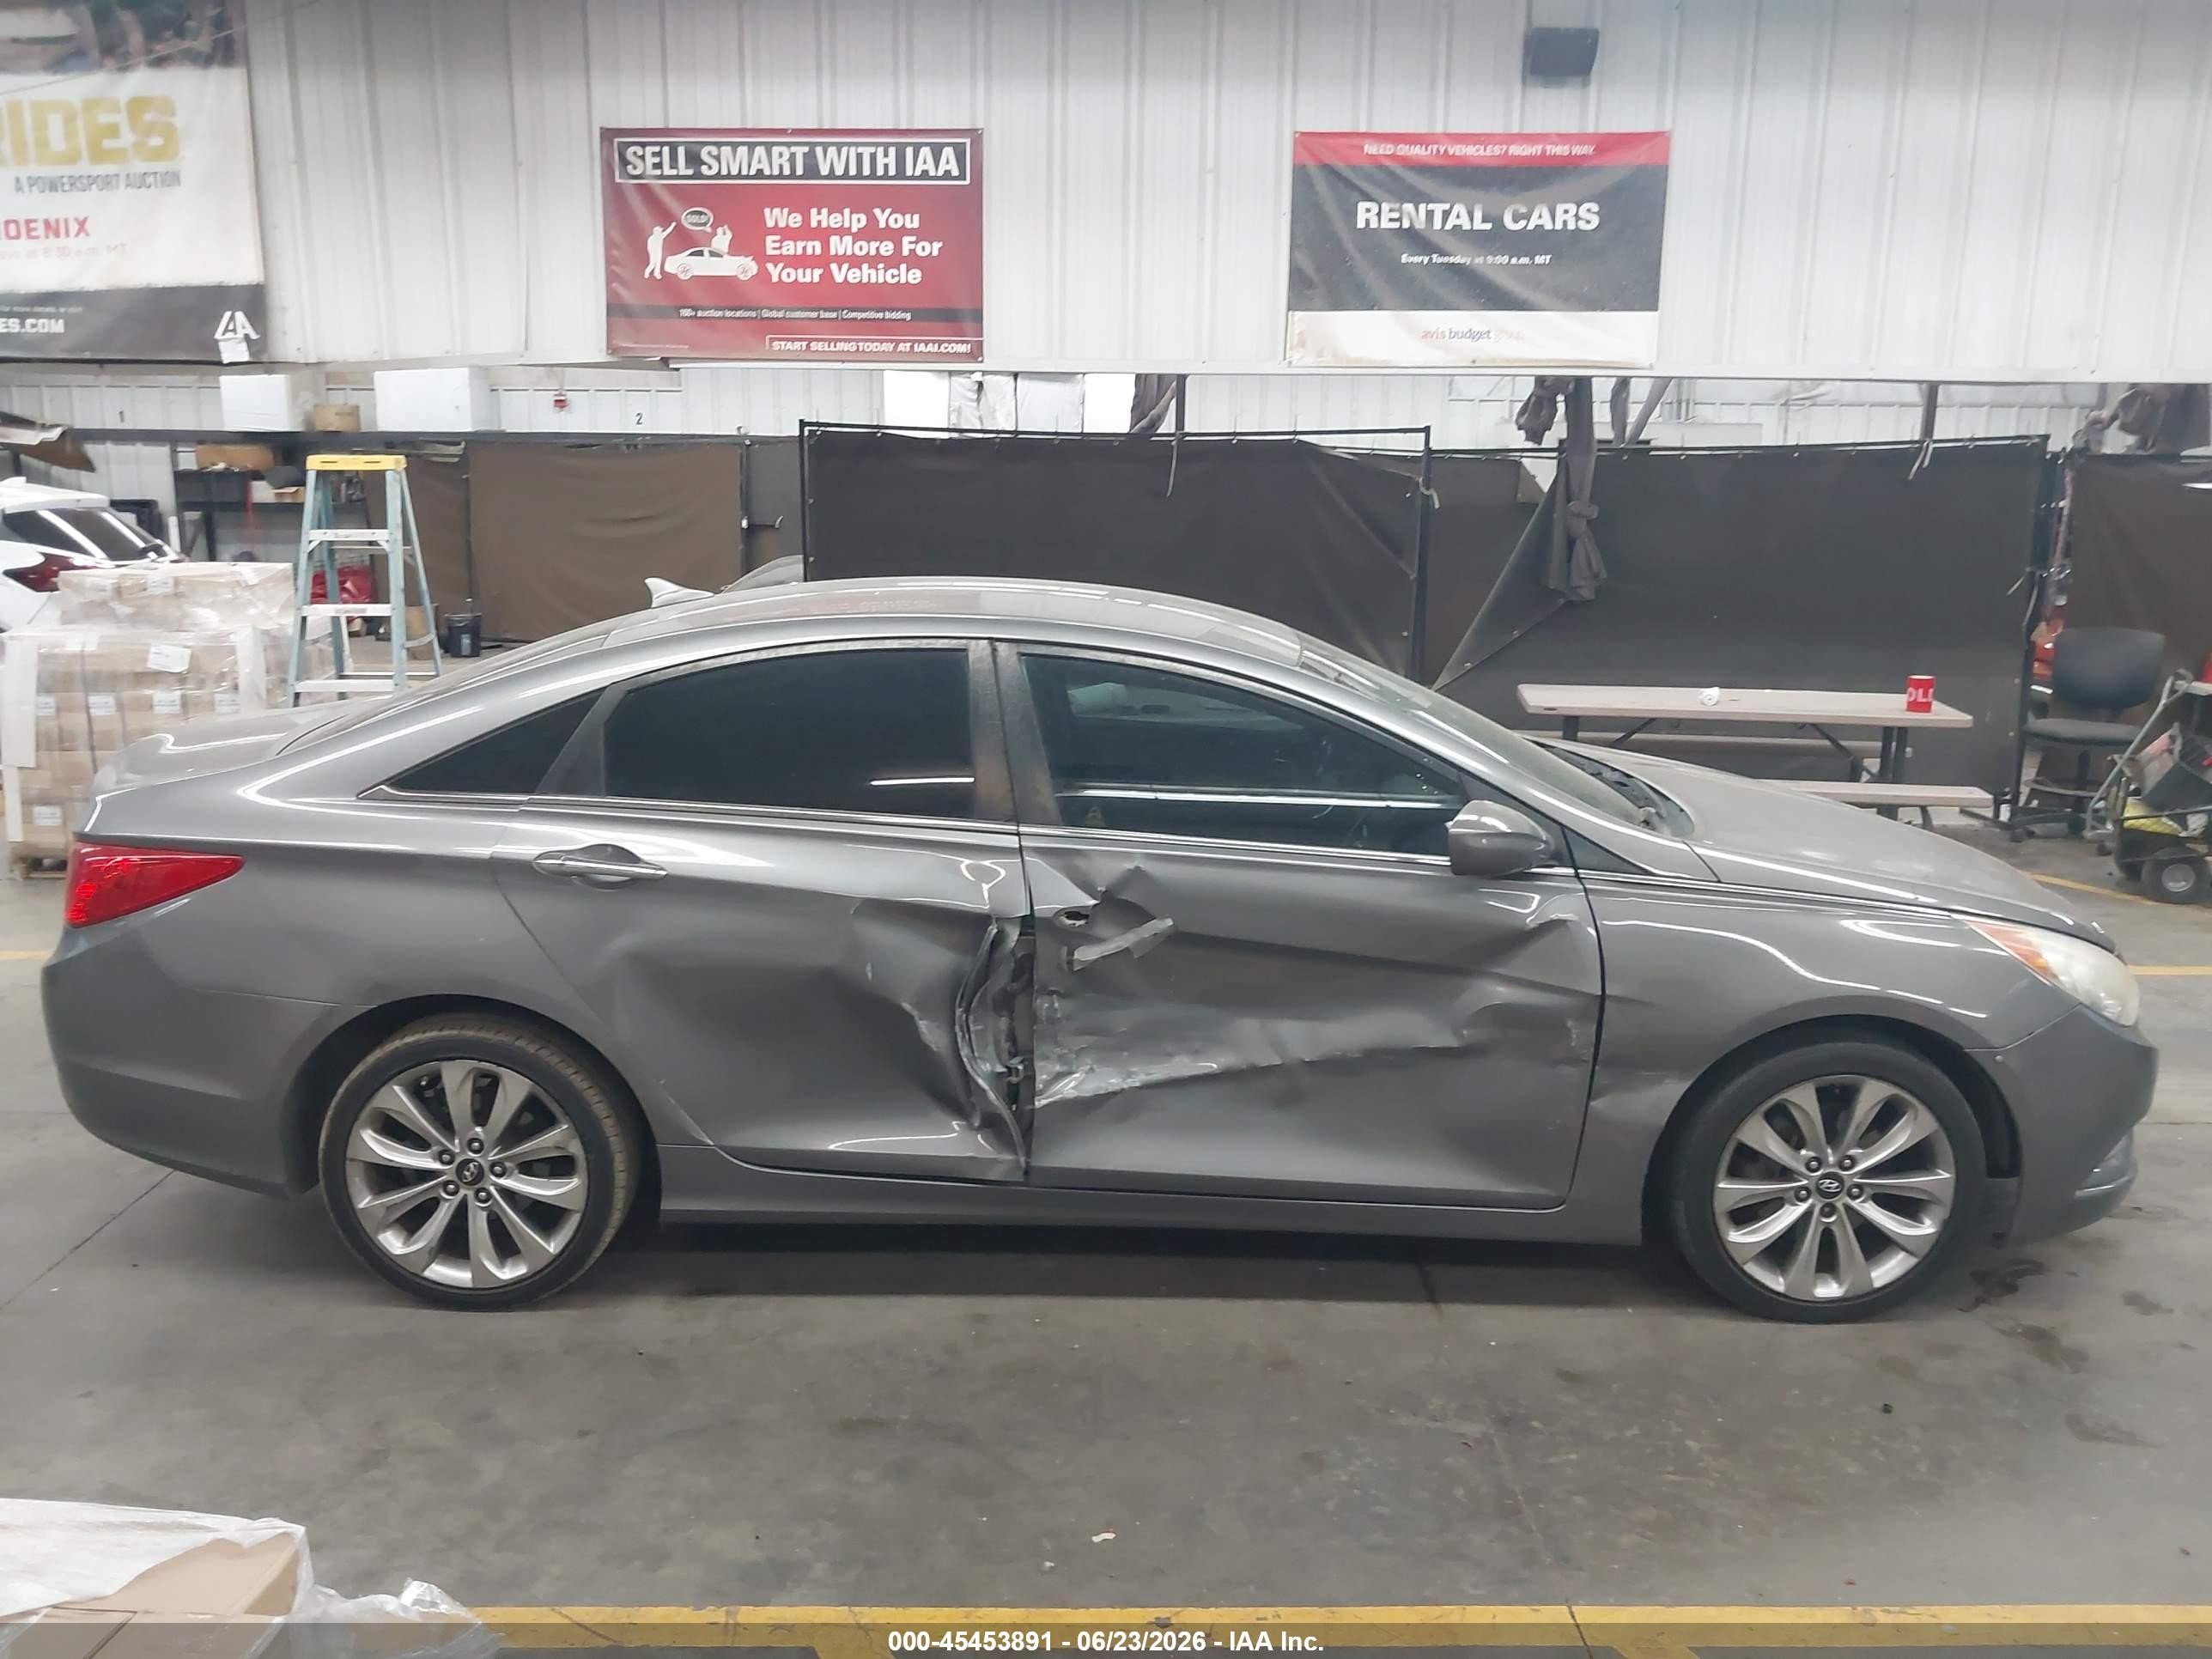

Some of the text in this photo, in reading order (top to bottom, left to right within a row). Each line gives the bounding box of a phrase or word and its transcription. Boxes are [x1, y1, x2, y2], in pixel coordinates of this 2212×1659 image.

[0, 96, 179, 166] IDES
[1364, 143, 1394, 155] NEED
[1396, 144, 1446, 155] QUALITY
[1448, 144, 1507, 156] VEHICLES?
[1509, 144, 1543, 156] RIGHT
[1545, 143, 1571, 156] THIS
[625, 146, 960, 177] SELL SMART WITH IAA
[15, 170, 181, 193] A POWERSPORT AUCTION
[763, 207, 920, 233] We Help You
[1356, 201, 1600, 231] RENTAL CARS
[0, 216, 90, 240] OENIX
[765, 234, 943, 257] Earn More For
[1401, 253, 1430, 266] Every
[1431, 254, 1471, 266] Tuesday
[765, 263, 922, 284] Your Vehicle
[696, 308, 724, 318] auction
[725, 308, 757, 318] locations
[761, 309, 785, 319] Global
[786, 310, 818, 319] customer
[819, 309, 837, 319] base
[842, 310, 884, 320] Competitive
[884, 310, 911, 321] bidding
[1422, 326, 1445, 340] avis
[1448, 327, 1492, 342] budget
[772, 341, 971, 354] START SELLING TODAY AT IAAI.COM!
[635, 412, 643, 425] 2
